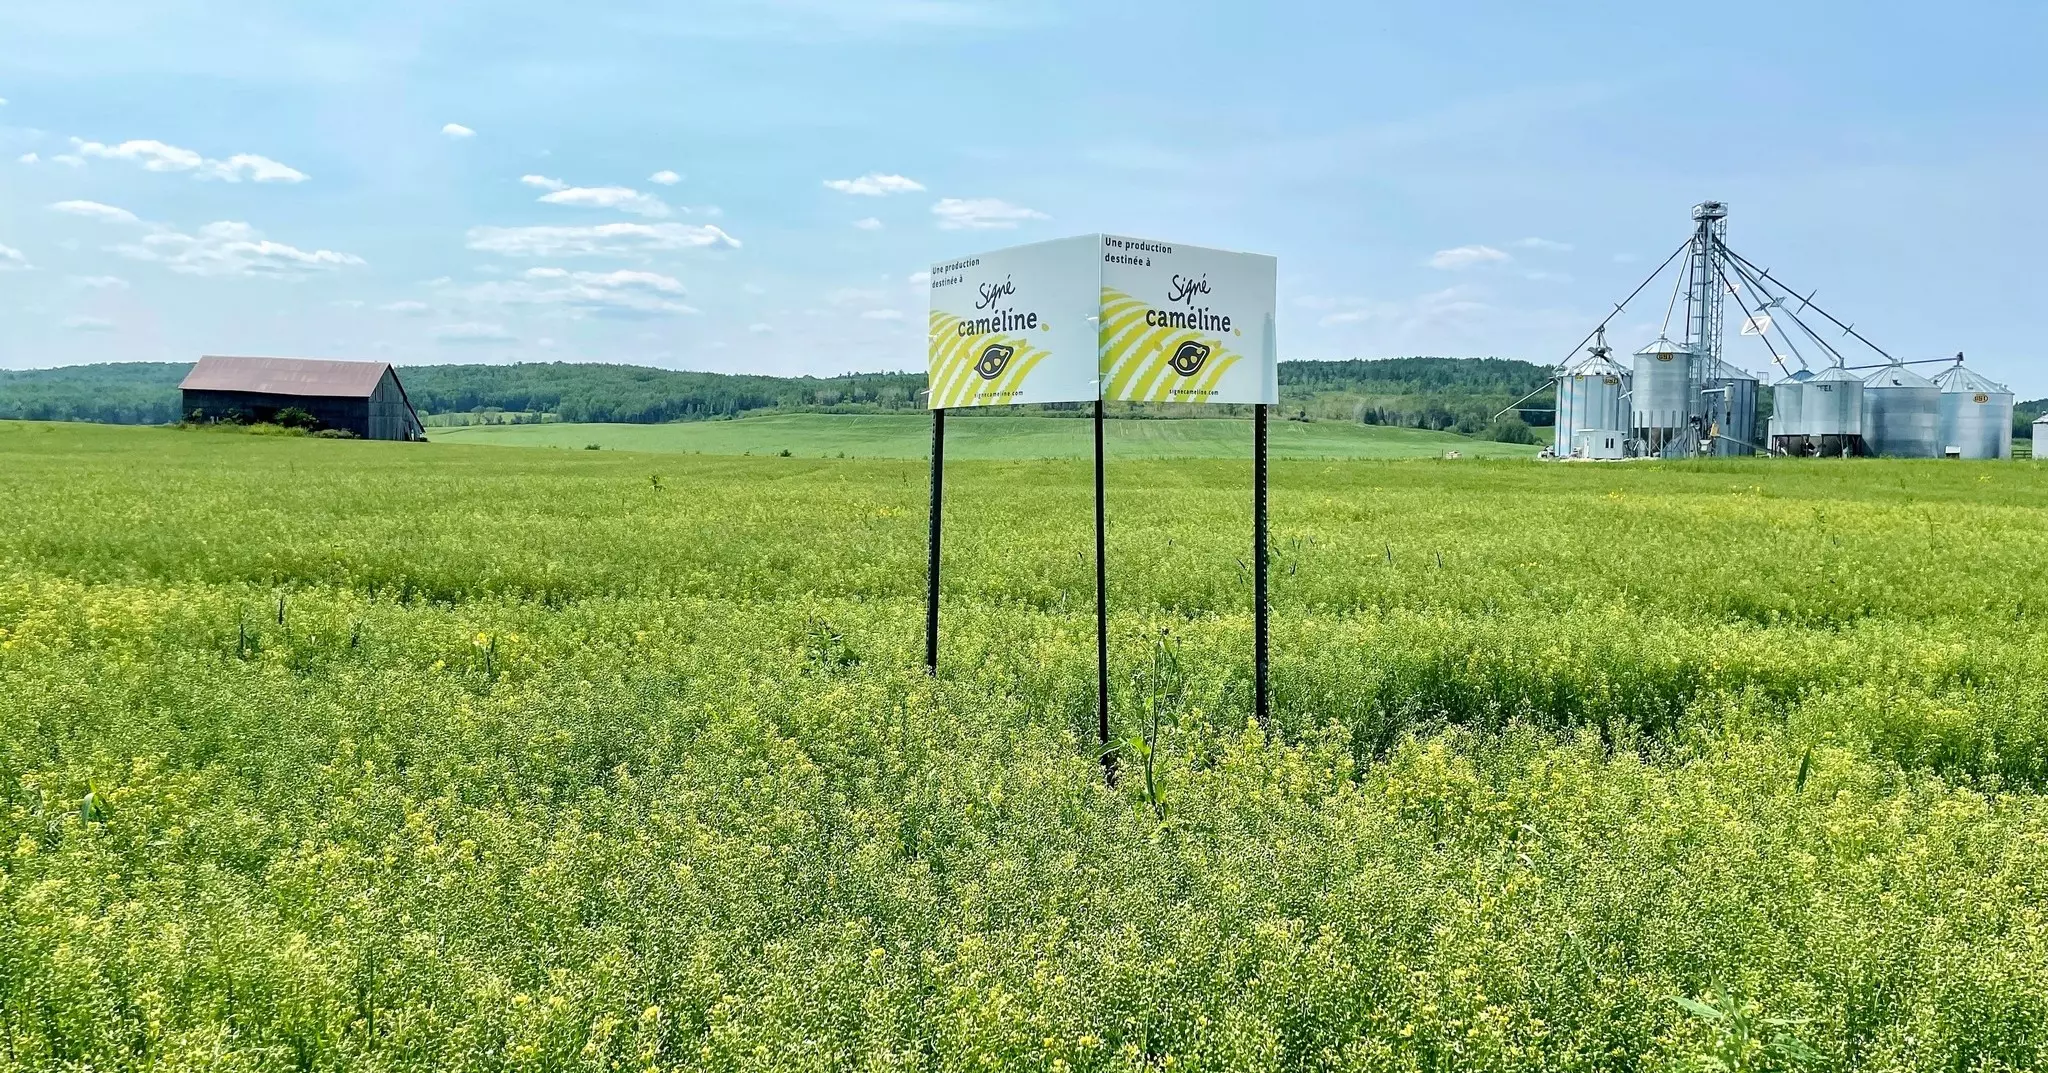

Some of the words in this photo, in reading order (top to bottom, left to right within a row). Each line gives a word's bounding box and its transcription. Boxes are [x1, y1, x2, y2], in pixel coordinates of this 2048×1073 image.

[1105, 237, 1123, 248] Une
[1125, 240, 1172, 254] production
[932, 264, 944, 275] Une
[945, 259, 980, 274] production
[1105, 254, 1143, 265] destinée
[1145, 257, 1151, 267] à
[932, 276, 958, 289] destinée
[958, 275, 963, 283] à
[975, 274, 1015, 309] Signé
[1168, 273, 1211, 305] Signé
[958, 308, 1037, 337] caméline
[1145, 306, 1231, 333] caméline
